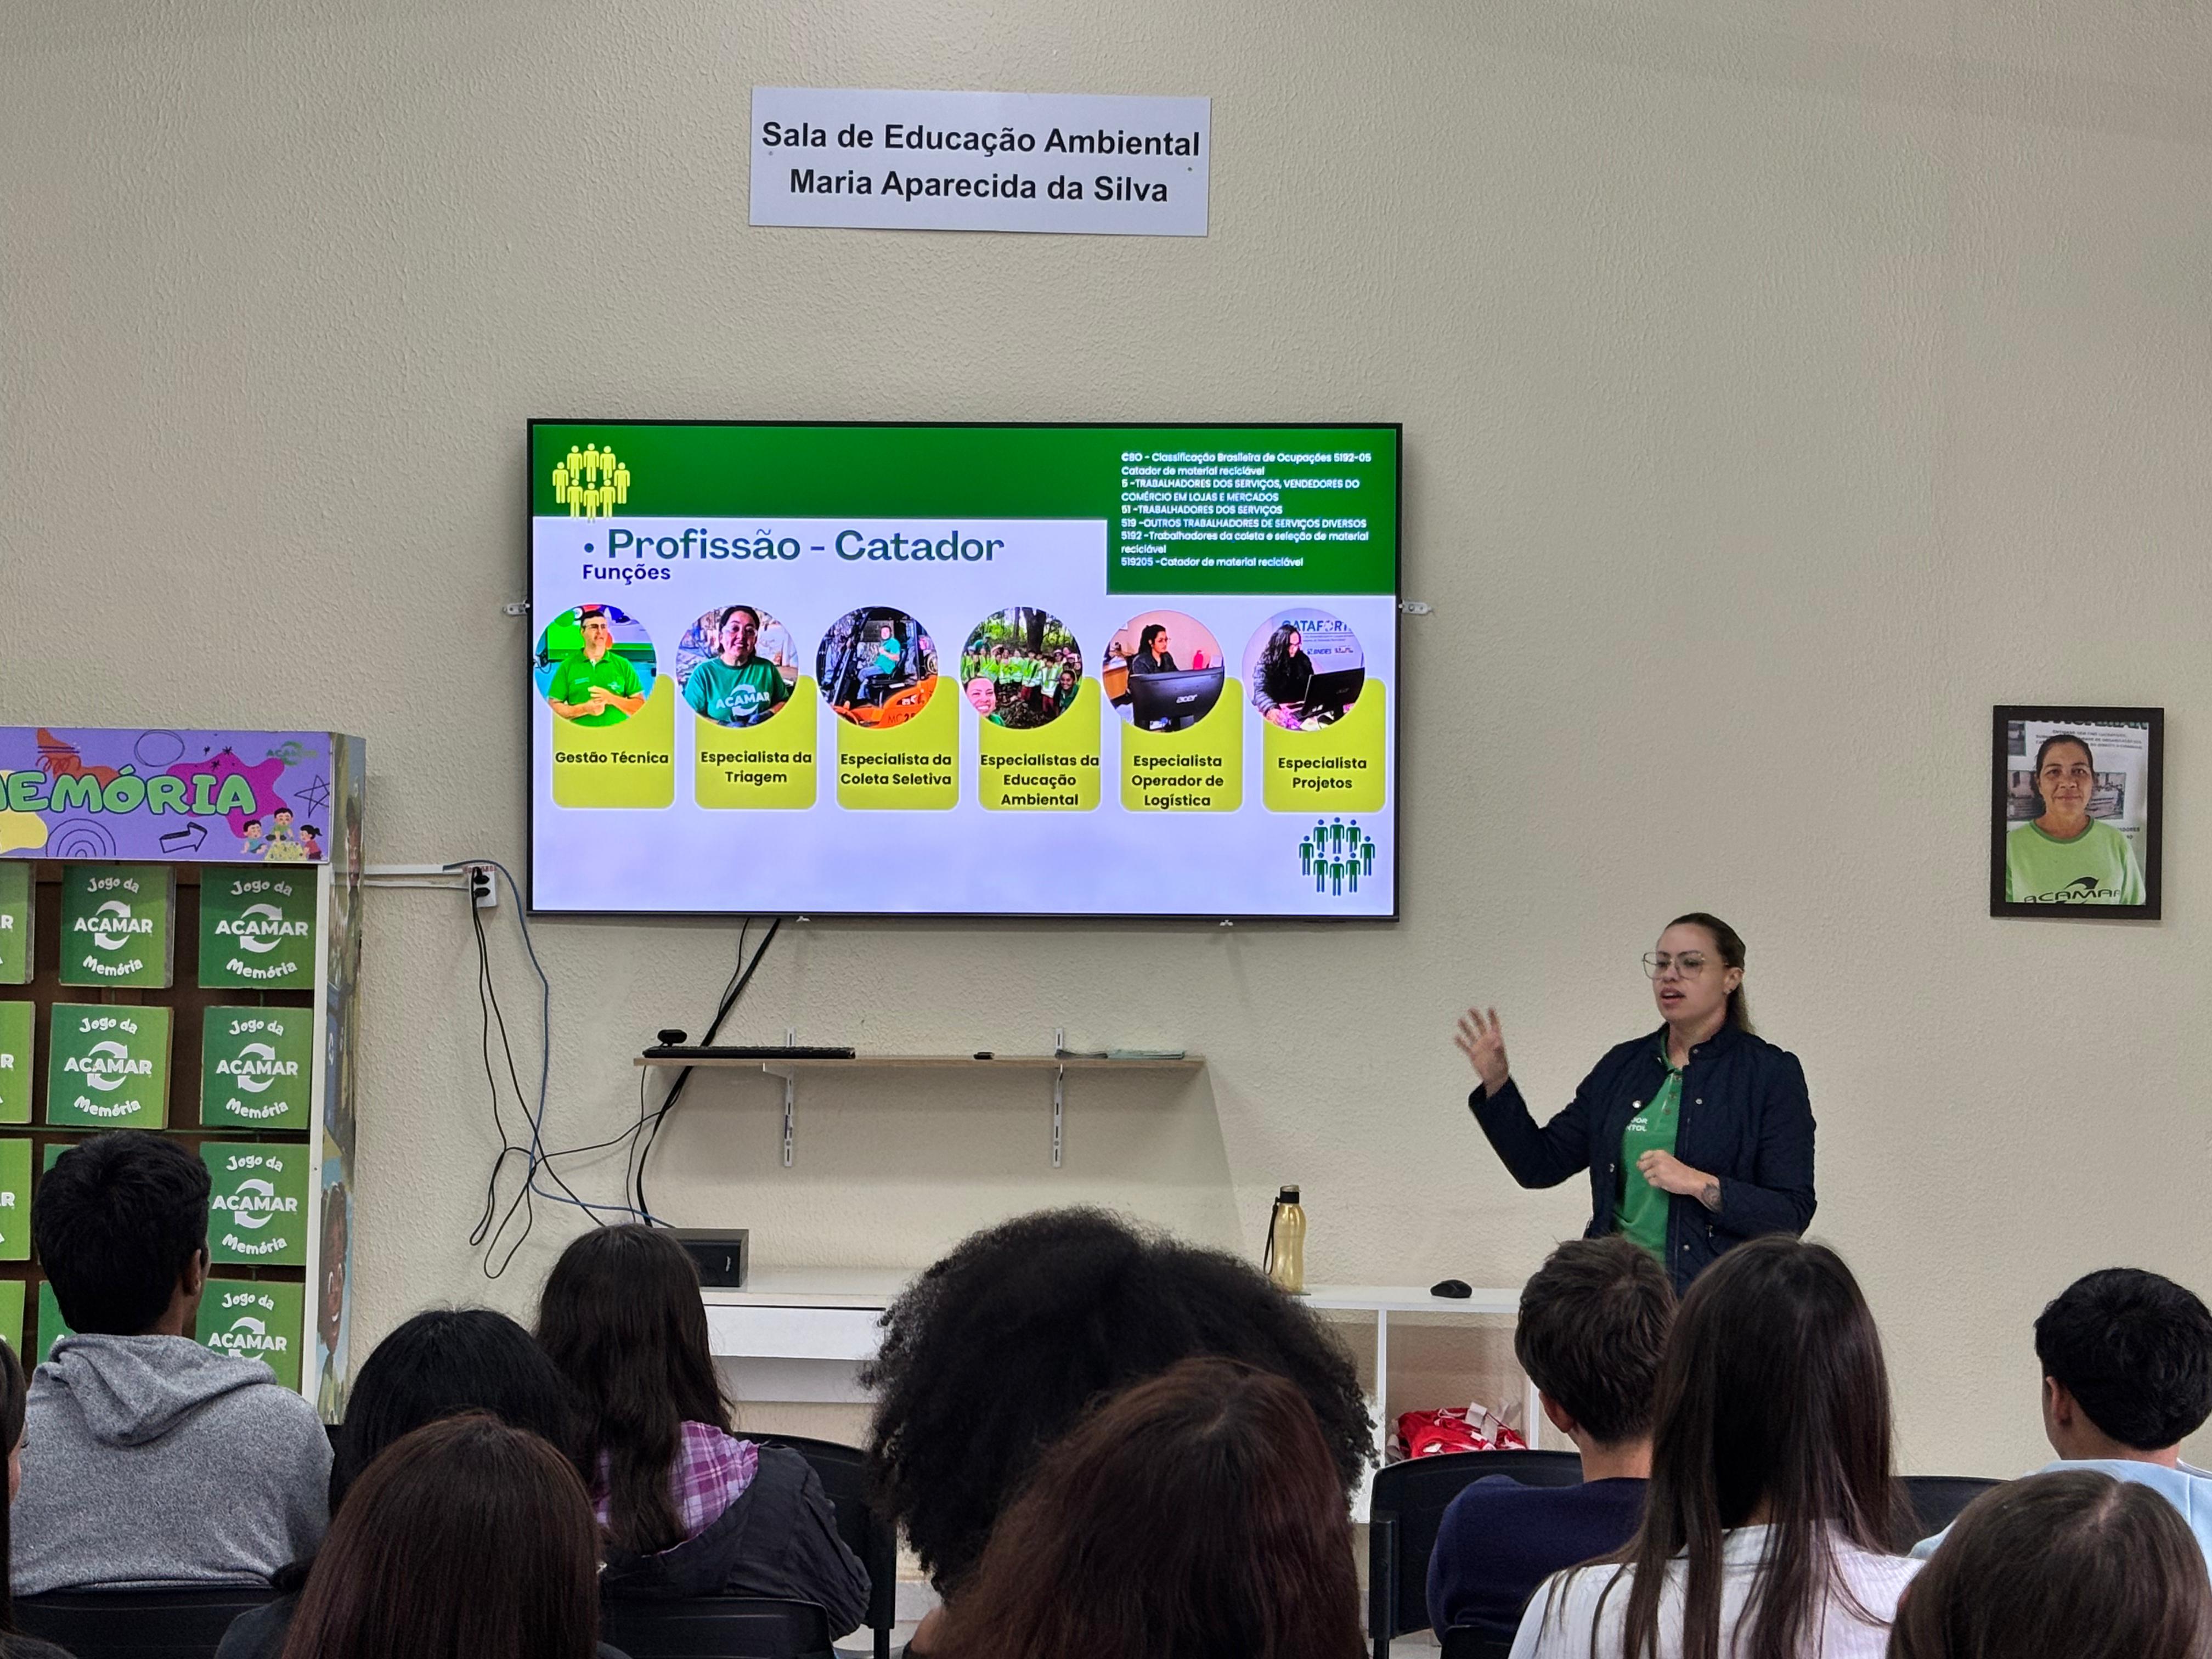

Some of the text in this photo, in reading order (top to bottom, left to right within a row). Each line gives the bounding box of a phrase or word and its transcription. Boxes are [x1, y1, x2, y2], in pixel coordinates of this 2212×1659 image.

[762, 122, 1199, 157] Sala de Educação Ambiental
[790, 169, 1168, 202] Maria Aparecida da Silva
[1152, 452, 1215, 464] Classificação
[1217, 452, 1261, 462] Brasileira
[1262, 452, 1275, 462] de
[1277, 452, 1331, 464] Ocupações
[1334, 453, 1372, 462] 5192-05
[1121, 466, 1265, 476] Catador de material reciclável
[1213, 479, 1233, 488] DOS
[1235, 479, 1282, 490] SERVIÇOS,
[1283, 479, 1343, 488] VENDEDORES
[1345, 479, 1360, 488] DO
[1121, 490, 1279, 502] COMÉRCIO EM LOJAS E MERCADOS
[1121, 505, 1131, 514] 51
[1216, 505, 1235, 514] DOS
[1238, 505, 1283, 517] SERVIÇOS
[1121, 518, 1136, 527] 519
[1183, 518, 1259, 528] TRABALHADORES
[1261, 519, 1273, 528] DE
[1275, 519, 1321, 531] SERVIÇOS
[1322, 519, 1367, 528] DIVERSOS
[608, 527, 800, 560] Profissão
[835, 530, 1005, 561] Catador
[1121, 531, 1142, 540] 5192
[1219, 531, 1233, 540] da
[1234, 531, 1265, 540] coleta
[1274, 531, 1312, 543] seleção
[1314, 531, 1327, 540] de
[1329, 531, 1369, 540] material
[1121, 544, 1166, 554] reciclável
[1121, 557, 1153, 566] 519205
[1201, 557, 1214, 566] de
[1216, 557, 1256, 566] material
[1258, 557, 1304, 566] reciclável
[583, 564, 670, 585] Funções
[716, 692, 770, 709] ACAMAR
[555, 751, 668, 764] Gestão Técnica
[701, 751, 812, 766] Especialista da
[840, 753, 951, 768] Especialista da
[980, 754, 1099, 769] Especialistas da
[1133, 754, 1222, 770] Especialista
[1278, 756, 1367, 771] Especialista
[725, 770, 787, 786] Triagem
[840, 772, 951, 786] Coleta Seletiva
[1003, 773, 1076, 789] Educação
[1132, 774, 1223, 790] Operador de
[1293, 776, 1352, 791] Projetos
[0, 764, 256, 815] EMÓRIA
[1001, 793, 1079, 806] Ambiental
[1144, 793, 1210, 810] Logística
[87, 877, 139, 893] Jogo da
[230, 880, 292, 896] Jogo da
[74, 917, 153, 933] ACAMAR
[215, 920, 308, 936] ACAMAR
[83, 955, 143, 977] Memória
[226, 958, 298, 979] Memória
[79, 1017, 138, 1034] Jogo da
[229, 1019, 284, 1036] Jogo da
[64, 1057, 152, 1074] ACAMAR
[216, 1059, 298, 1075] ACAMAR
[74, 1096, 141, 1117] Memória
[226, 1098, 289, 1119] Memória
[226, 1155, 283, 1172] Jogo da
[212, 1195, 298, 1211] ACAMAR
[222, 1233, 287, 1255] Memória
[222, 1293, 274, 1311] Jogo da
[208, 1333, 287, 1351] ACAMAR
